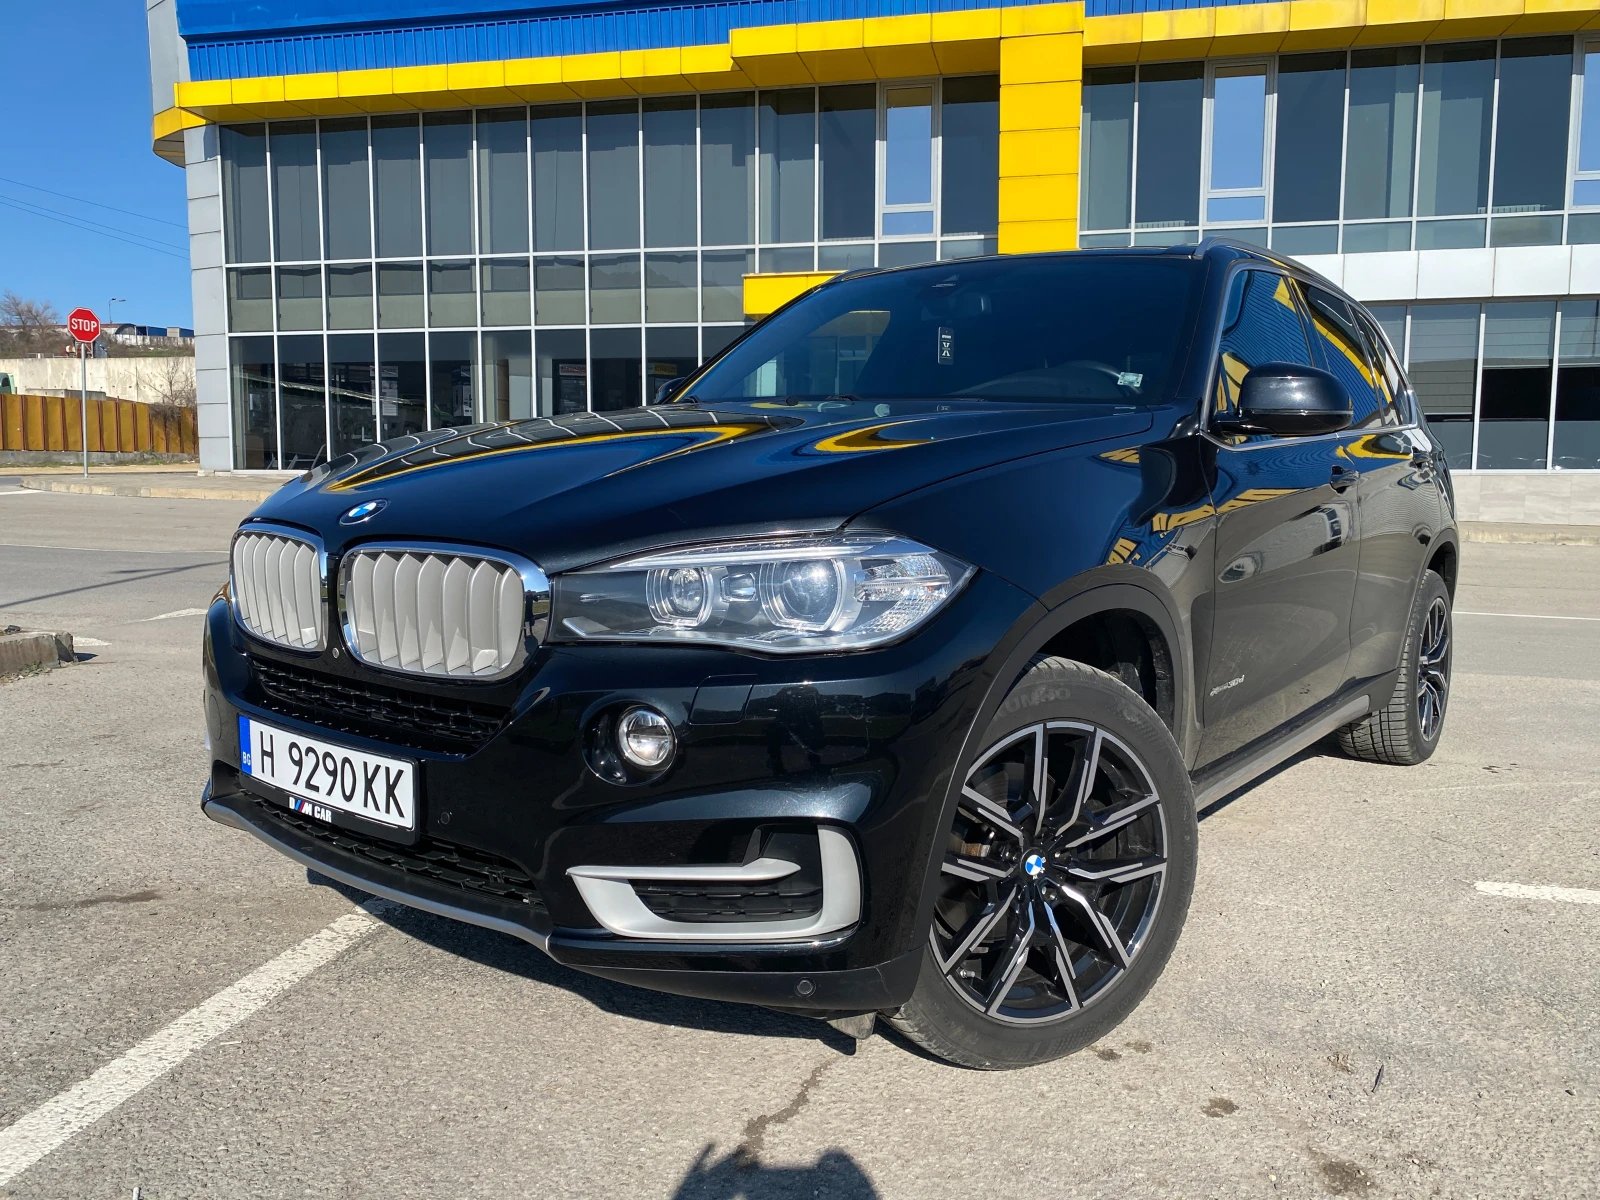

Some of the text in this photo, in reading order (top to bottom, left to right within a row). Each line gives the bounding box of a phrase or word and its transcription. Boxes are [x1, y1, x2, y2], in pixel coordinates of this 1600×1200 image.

[71, 317, 97, 332] STOP
[242, 751, 251, 766] BG
[260, 731, 275, 778] H
[314, 805, 332, 823] CAR
